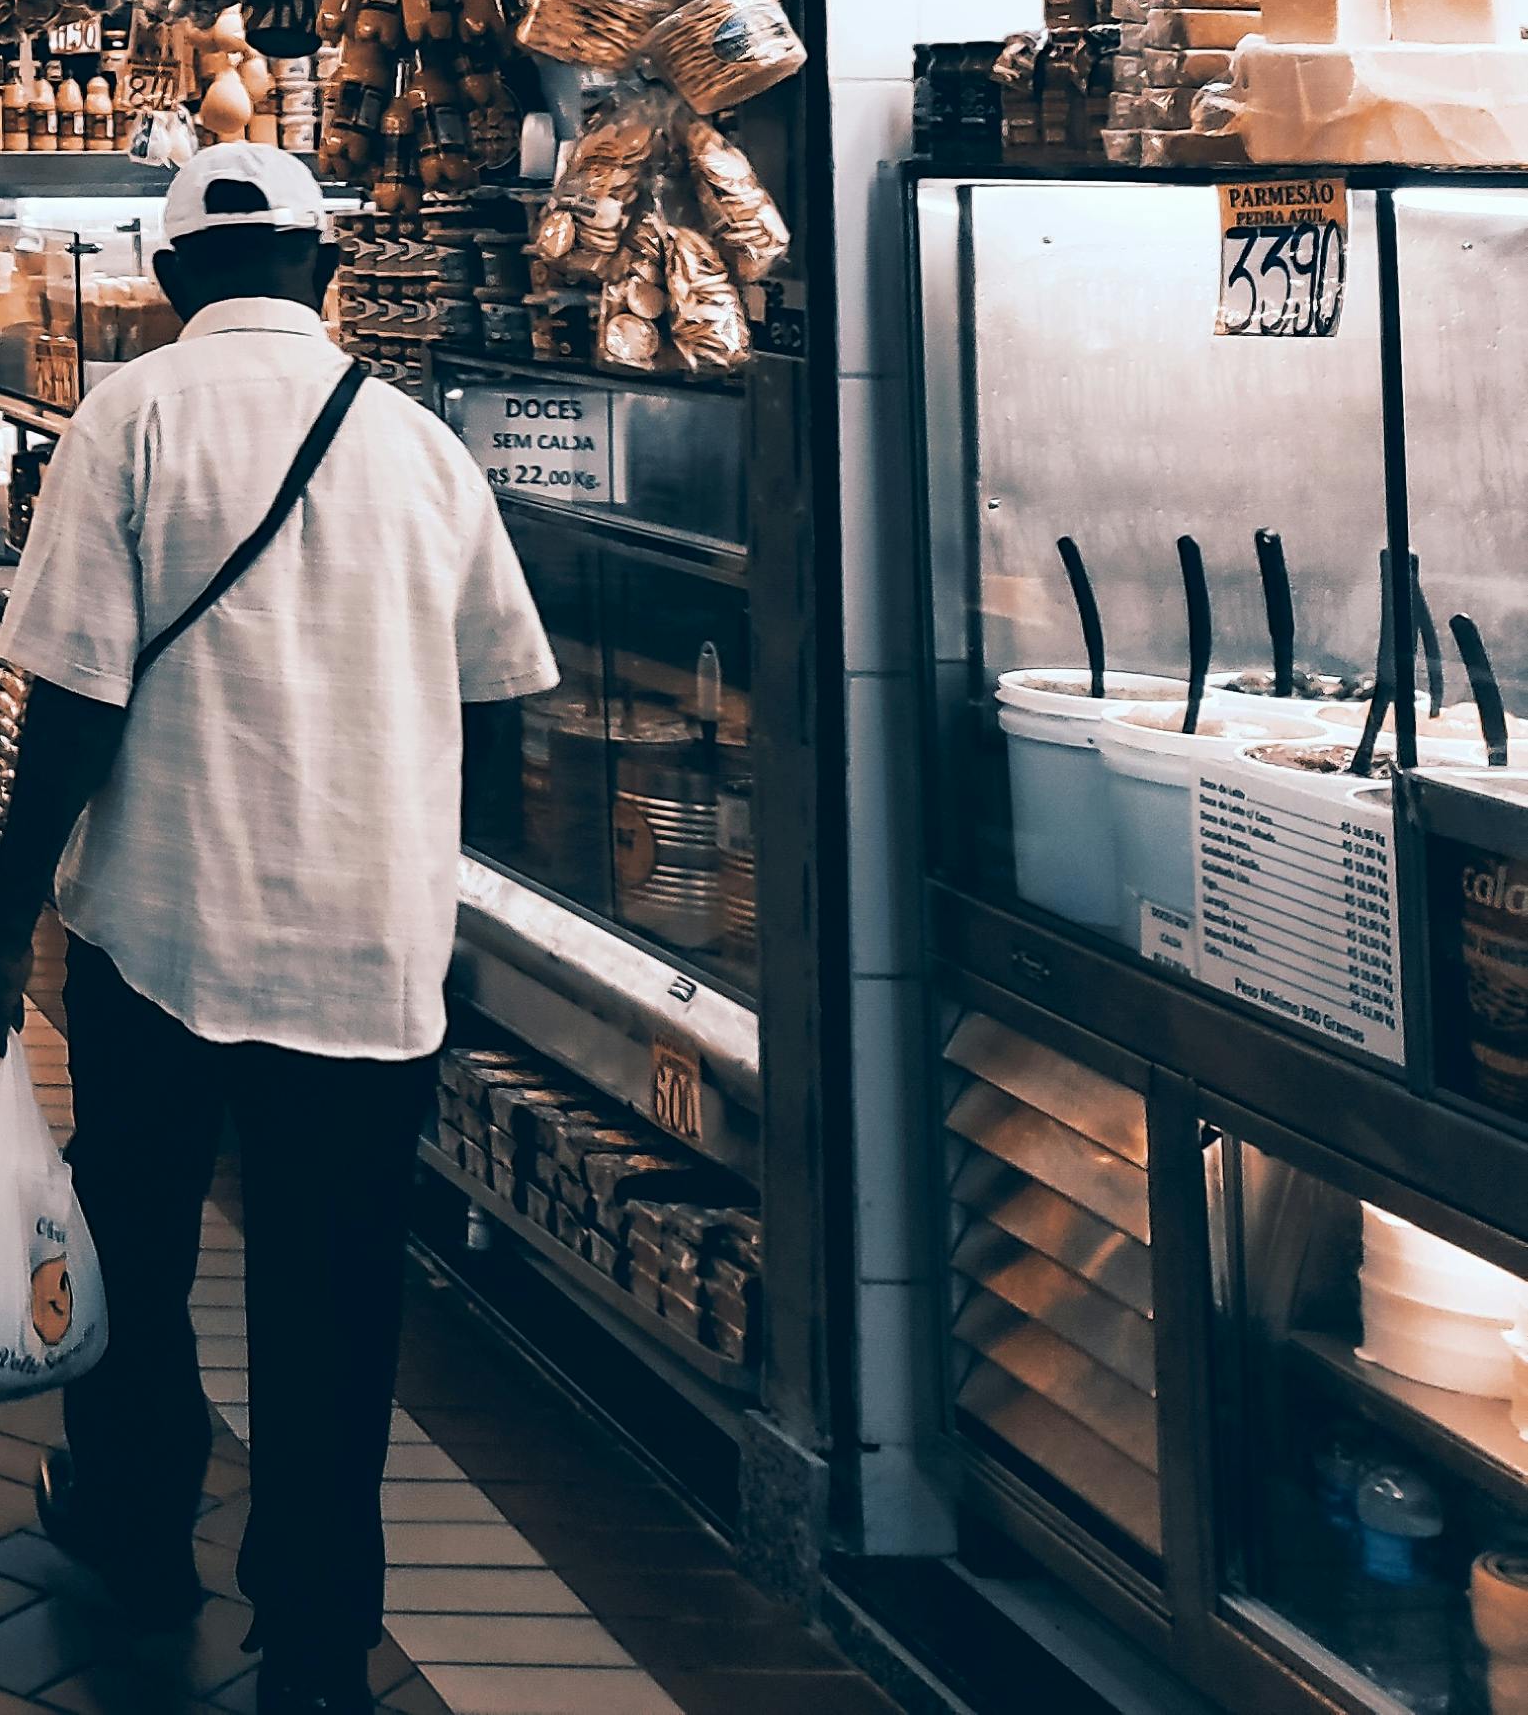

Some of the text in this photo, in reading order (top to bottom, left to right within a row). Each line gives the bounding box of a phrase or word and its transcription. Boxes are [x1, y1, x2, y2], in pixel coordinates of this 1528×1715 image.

[1229, 182, 1334, 207] PARMESÃO
[1236, 208, 1325, 225] PEDRA AZUL
[506, 398, 582, 420] DOCES
[493, 434, 531, 449] SEM
[487, 468, 509, 485] R$
[515, 466, 571, 487] 22,00
